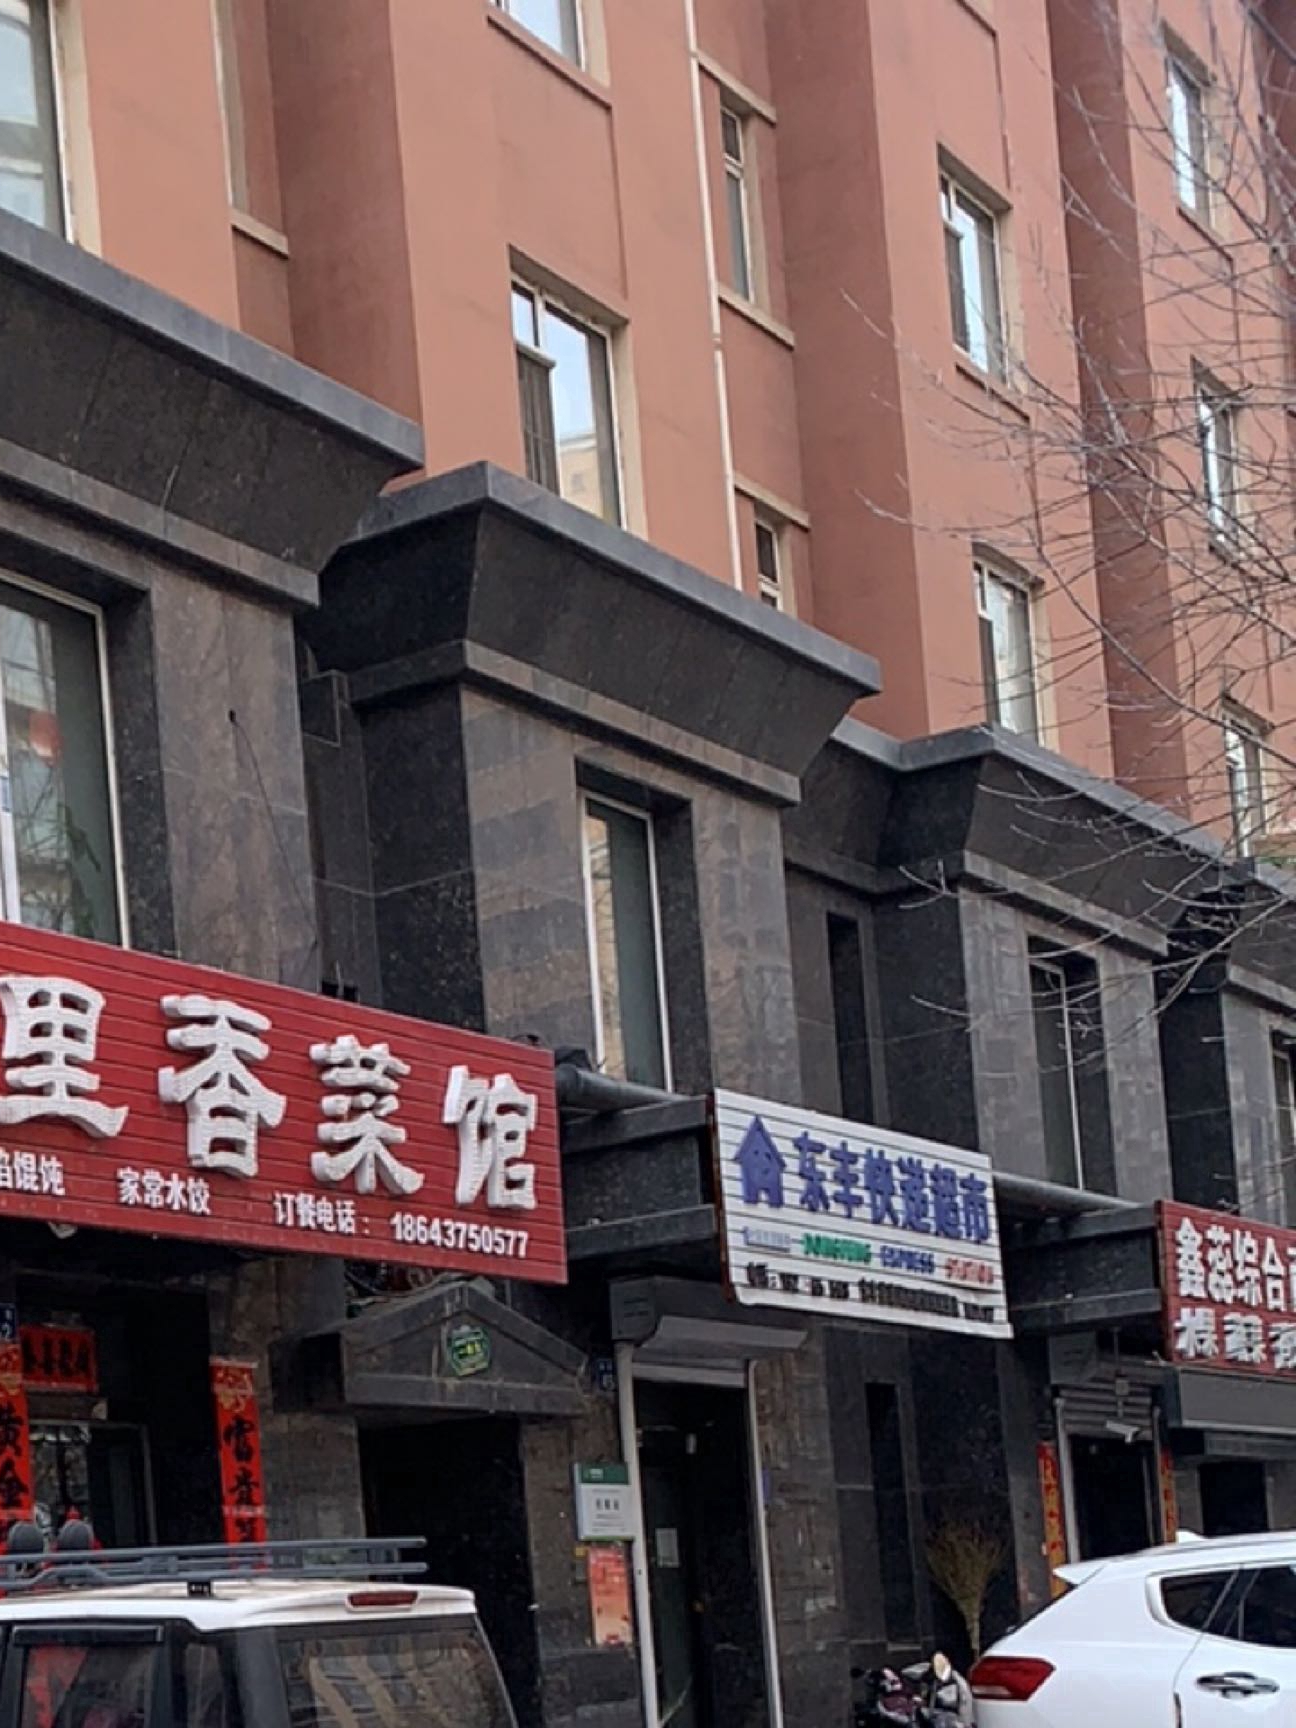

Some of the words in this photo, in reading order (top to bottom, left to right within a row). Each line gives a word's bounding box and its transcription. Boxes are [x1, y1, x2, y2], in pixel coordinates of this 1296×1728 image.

[116, 1166, 212, 1216] 家常水饺
[389, 1211, 529, 1259] 18643750577
